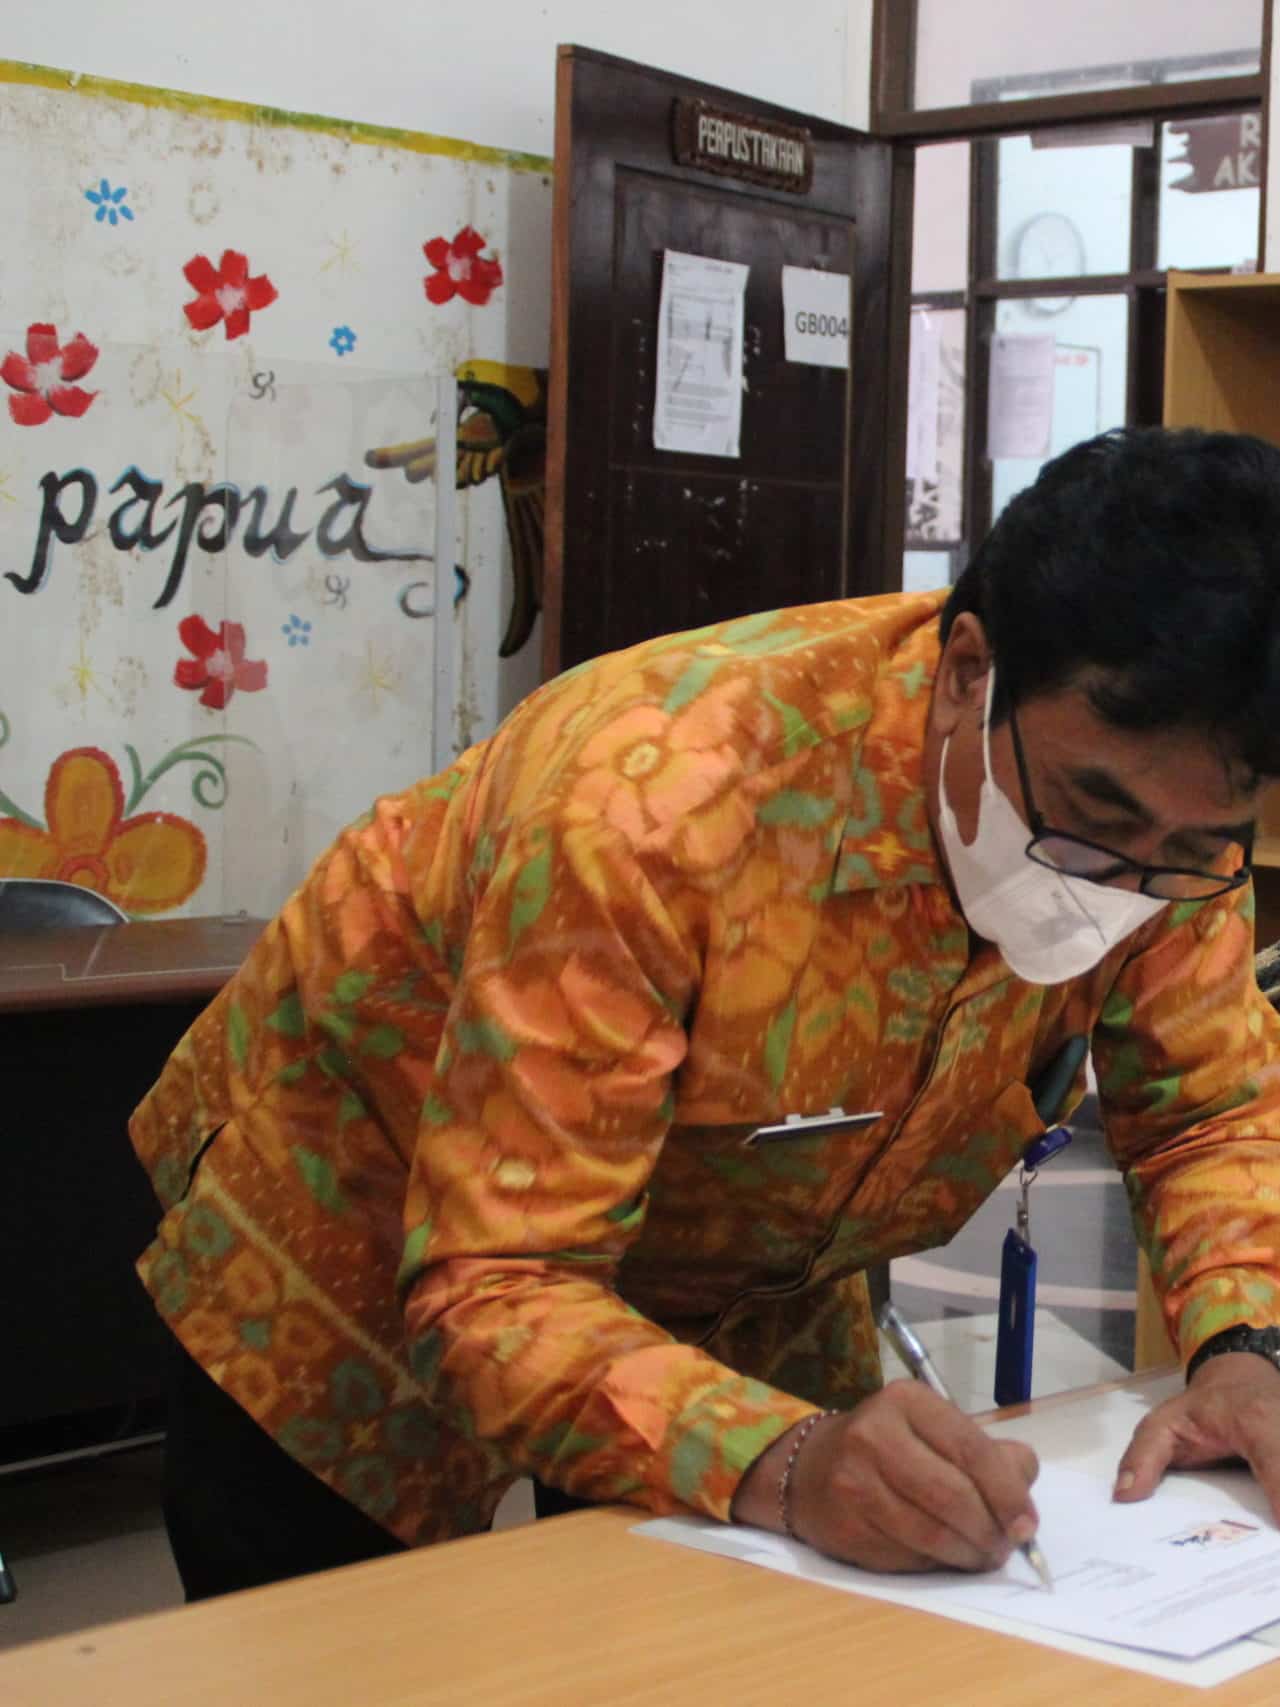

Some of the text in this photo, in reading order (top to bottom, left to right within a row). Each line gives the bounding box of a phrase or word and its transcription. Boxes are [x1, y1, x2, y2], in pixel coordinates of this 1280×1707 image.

[699, 115, 804, 176] PERPUSTAKAAN
[795, 311, 848, 337] GB004
[3, 465, 435, 610] papua
